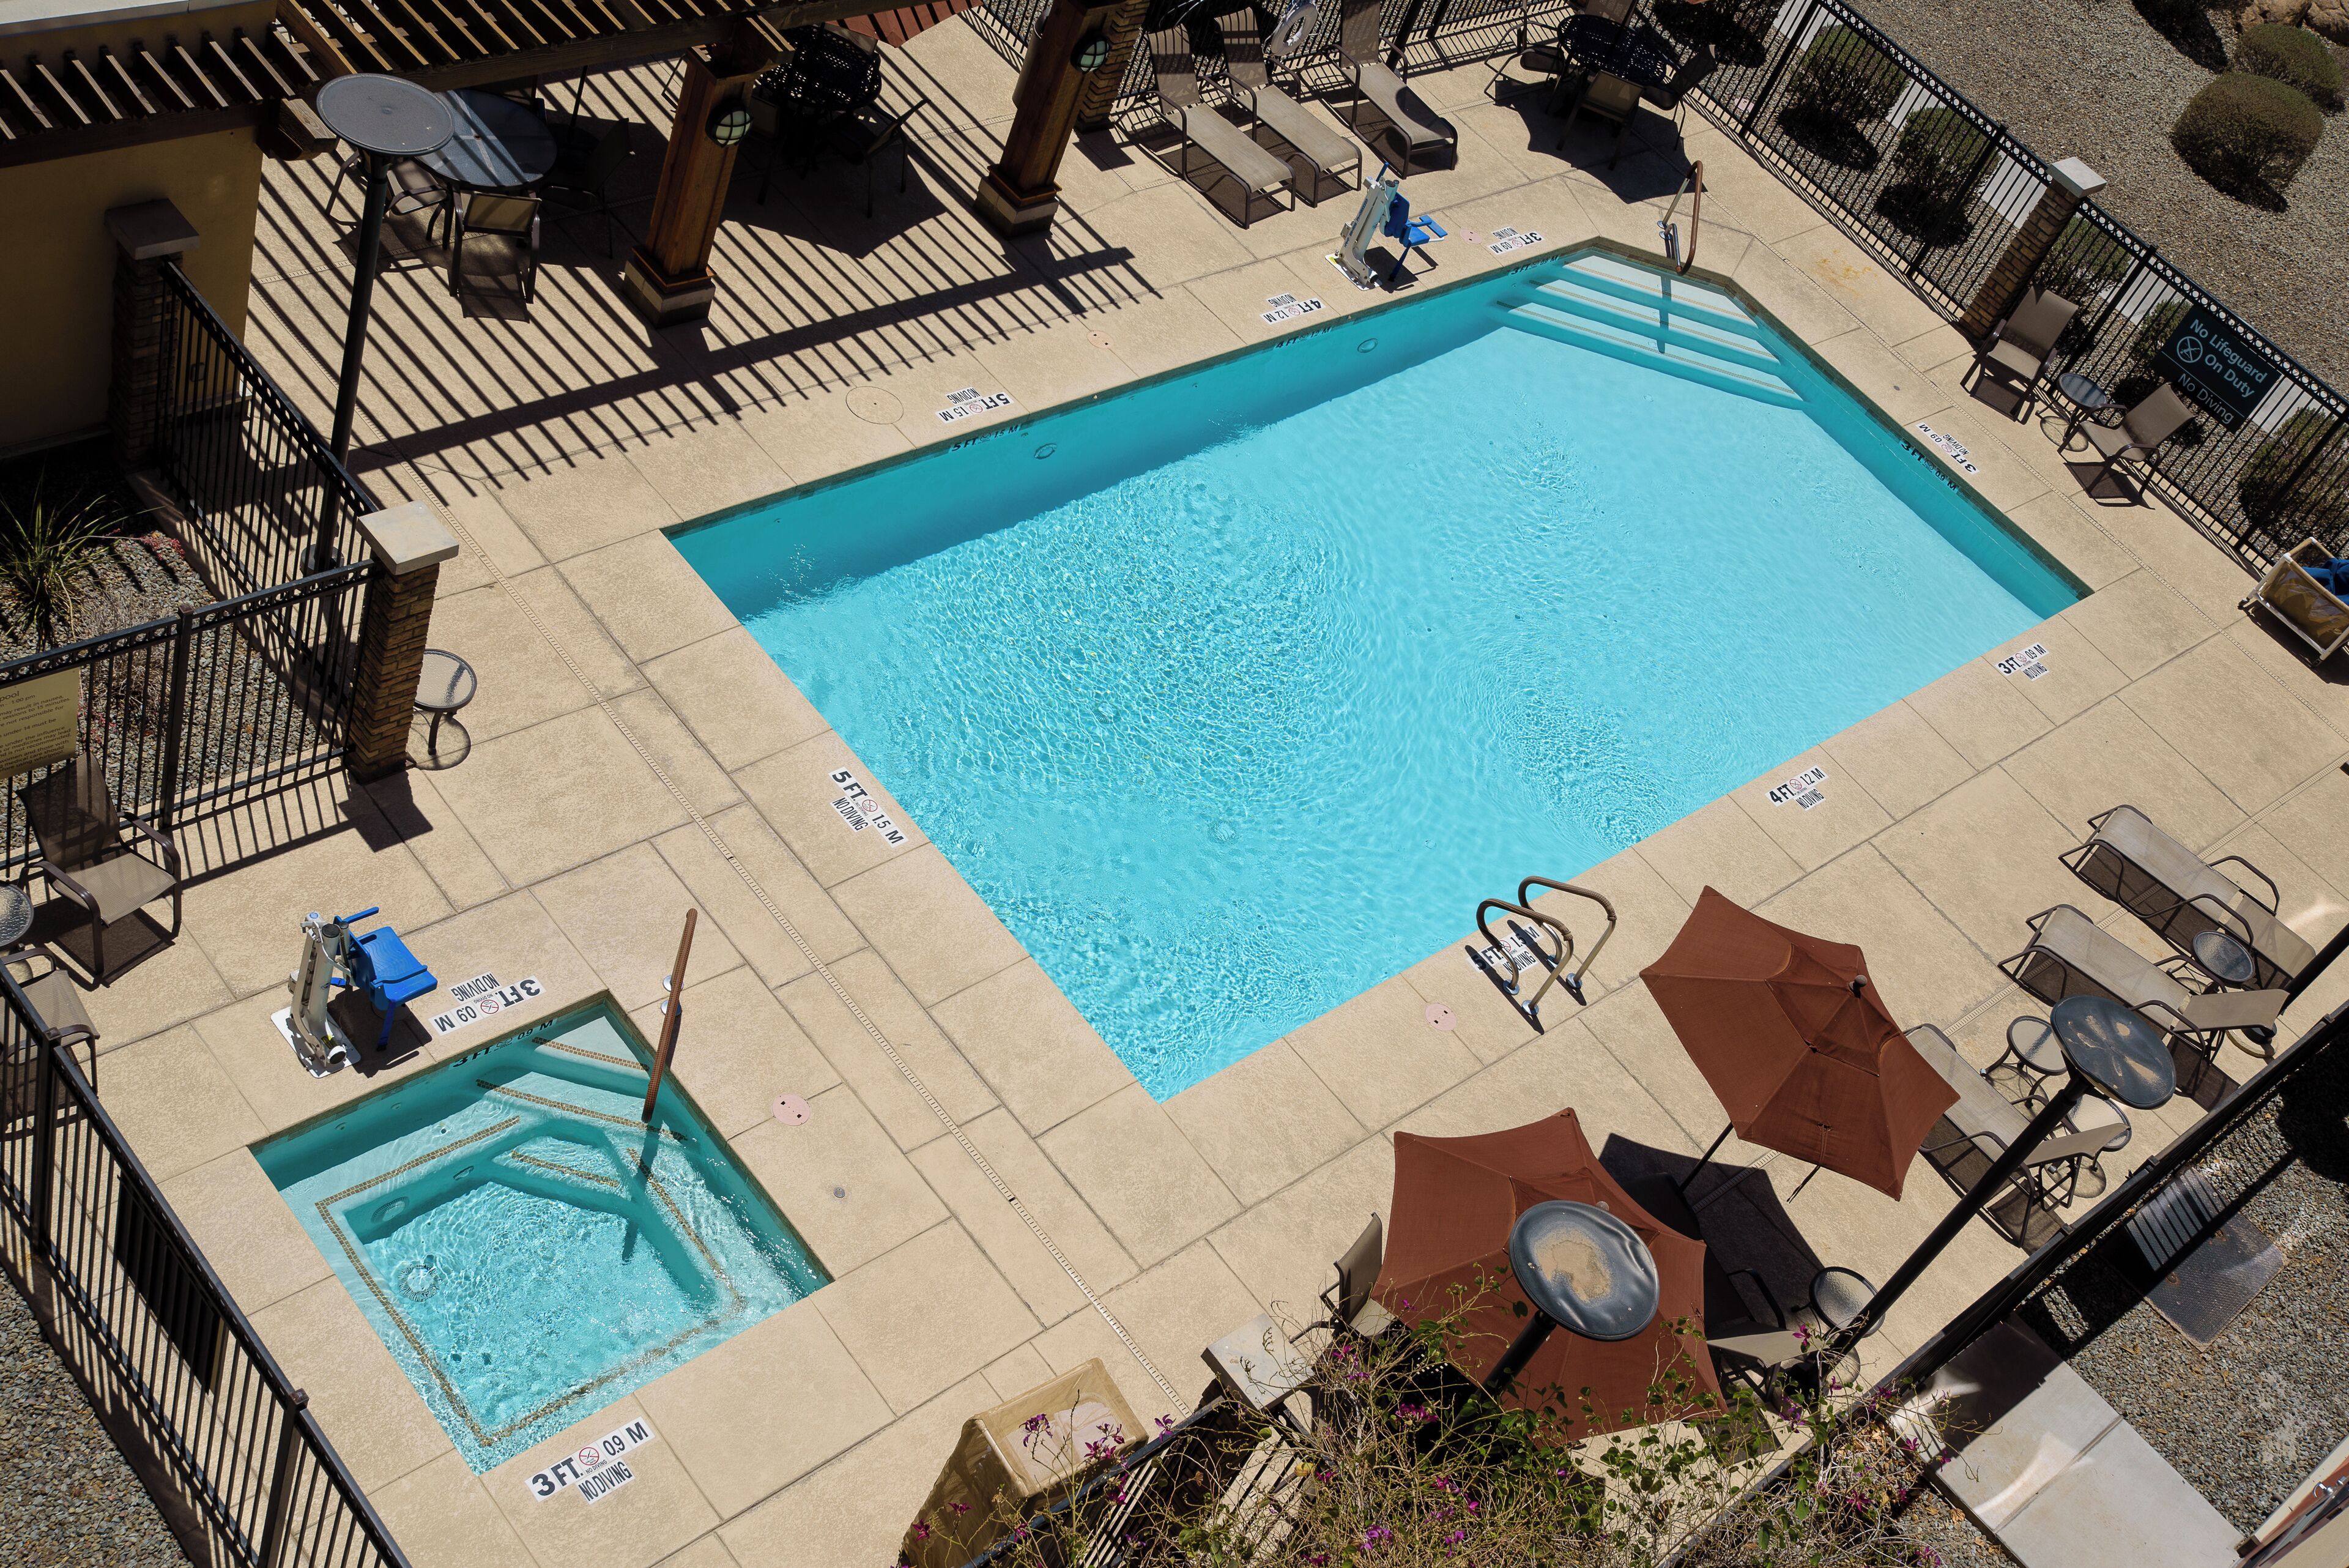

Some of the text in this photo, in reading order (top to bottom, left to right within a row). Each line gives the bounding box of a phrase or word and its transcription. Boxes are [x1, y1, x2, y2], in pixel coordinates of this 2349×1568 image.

[1529, 232, 1542, 241] 3
[1490, 245, 1503, 253] M
[1310, 299, 1321, 309] 4
[2190, 319, 2268, 383] No Lifeguard
[2205, 354, 2255, 398] On Duty
[979, 396, 1000, 409] FT.
[996, 393, 1011, 404] 5
[2178, 373, 2234, 424] No Diving
[939, 411, 954, 421] M
[953, 406, 969, 417] 1.5
[1919, 424, 1931, 433] M
[952, 442, 961, 451] 5
[1008, 425, 1019, 434] M
[1901, 440, 1912, 451] 3
[1947, 480, 1958, 491] M
[1965, 464, 1976, 472] 3
[1998, 663, 2012, 674] 3
[2005, 656, 2022, 671] FT.
[2033, 644, 2046, 655] M
[3, 710, 27, 719] sessions
[15, 704, 31, 712] result
[19, 708, 54, 721] responsible
[4, 728, 22, 737] under
[37, 726, 65, 737] influence
[12, 738, 42, 749] medicines
[5, 756, 28, 767] medical
[44, 745, 64, 754] should
[1769, 768, 1825, 803] 4 FT. 1.2 M
[832, 771, 904, 844] 5 FT. 1.5 M
[832, 797, 869, 831] NO DIVING
[858, 807, 869, 816] DIVING
[1472, 926, 1540, 970] 5 FT. 1.5 M
[450, 973, 500, 1001] NO DIVING
[434, 979, 541, 1032] 3 FT. 0.9 M
[473, 995, 488, 1004] DIVING
[453, 1057, 468, 1068] 3
[518, 1028, 533, 1040] 0.9
[540, 1019, 553, 1031] M
[532, 1421, 649, 1496] 3 FT. 0.9 M
[593, 1459, 607, 1471] DIVING
[578, 1461, 633, 1501] NO DIVING
